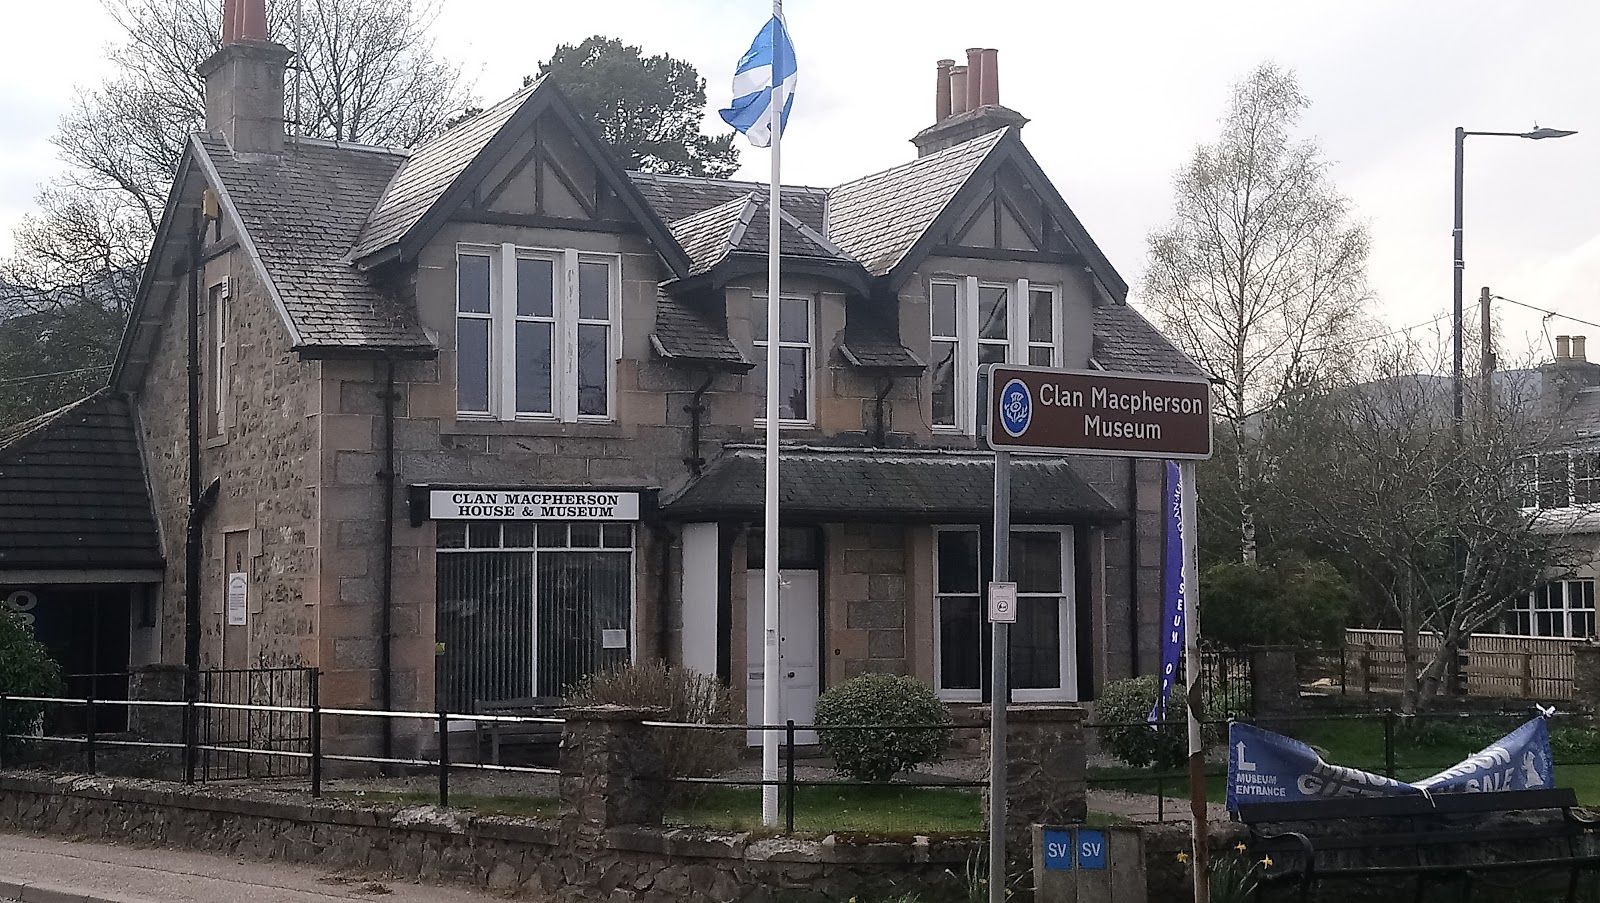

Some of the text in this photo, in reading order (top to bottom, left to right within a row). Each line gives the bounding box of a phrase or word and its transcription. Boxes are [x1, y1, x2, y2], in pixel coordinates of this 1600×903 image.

[1039, 383, 1203, 415] Clan Macpherson
[1084, 414, 1161, 439] Museum
[452, 493, 619, 505] CLAN MACPHERSON
[458, 505, 614, 518] HOUSE & MUSEUM
[1236, 773, 1277, 785] MUSEUM
[1235, 784, 1286, 797] ENTRANCE
[1048, 842, 1067, 858] SV
[1082, 842, 1101, 857] SV
